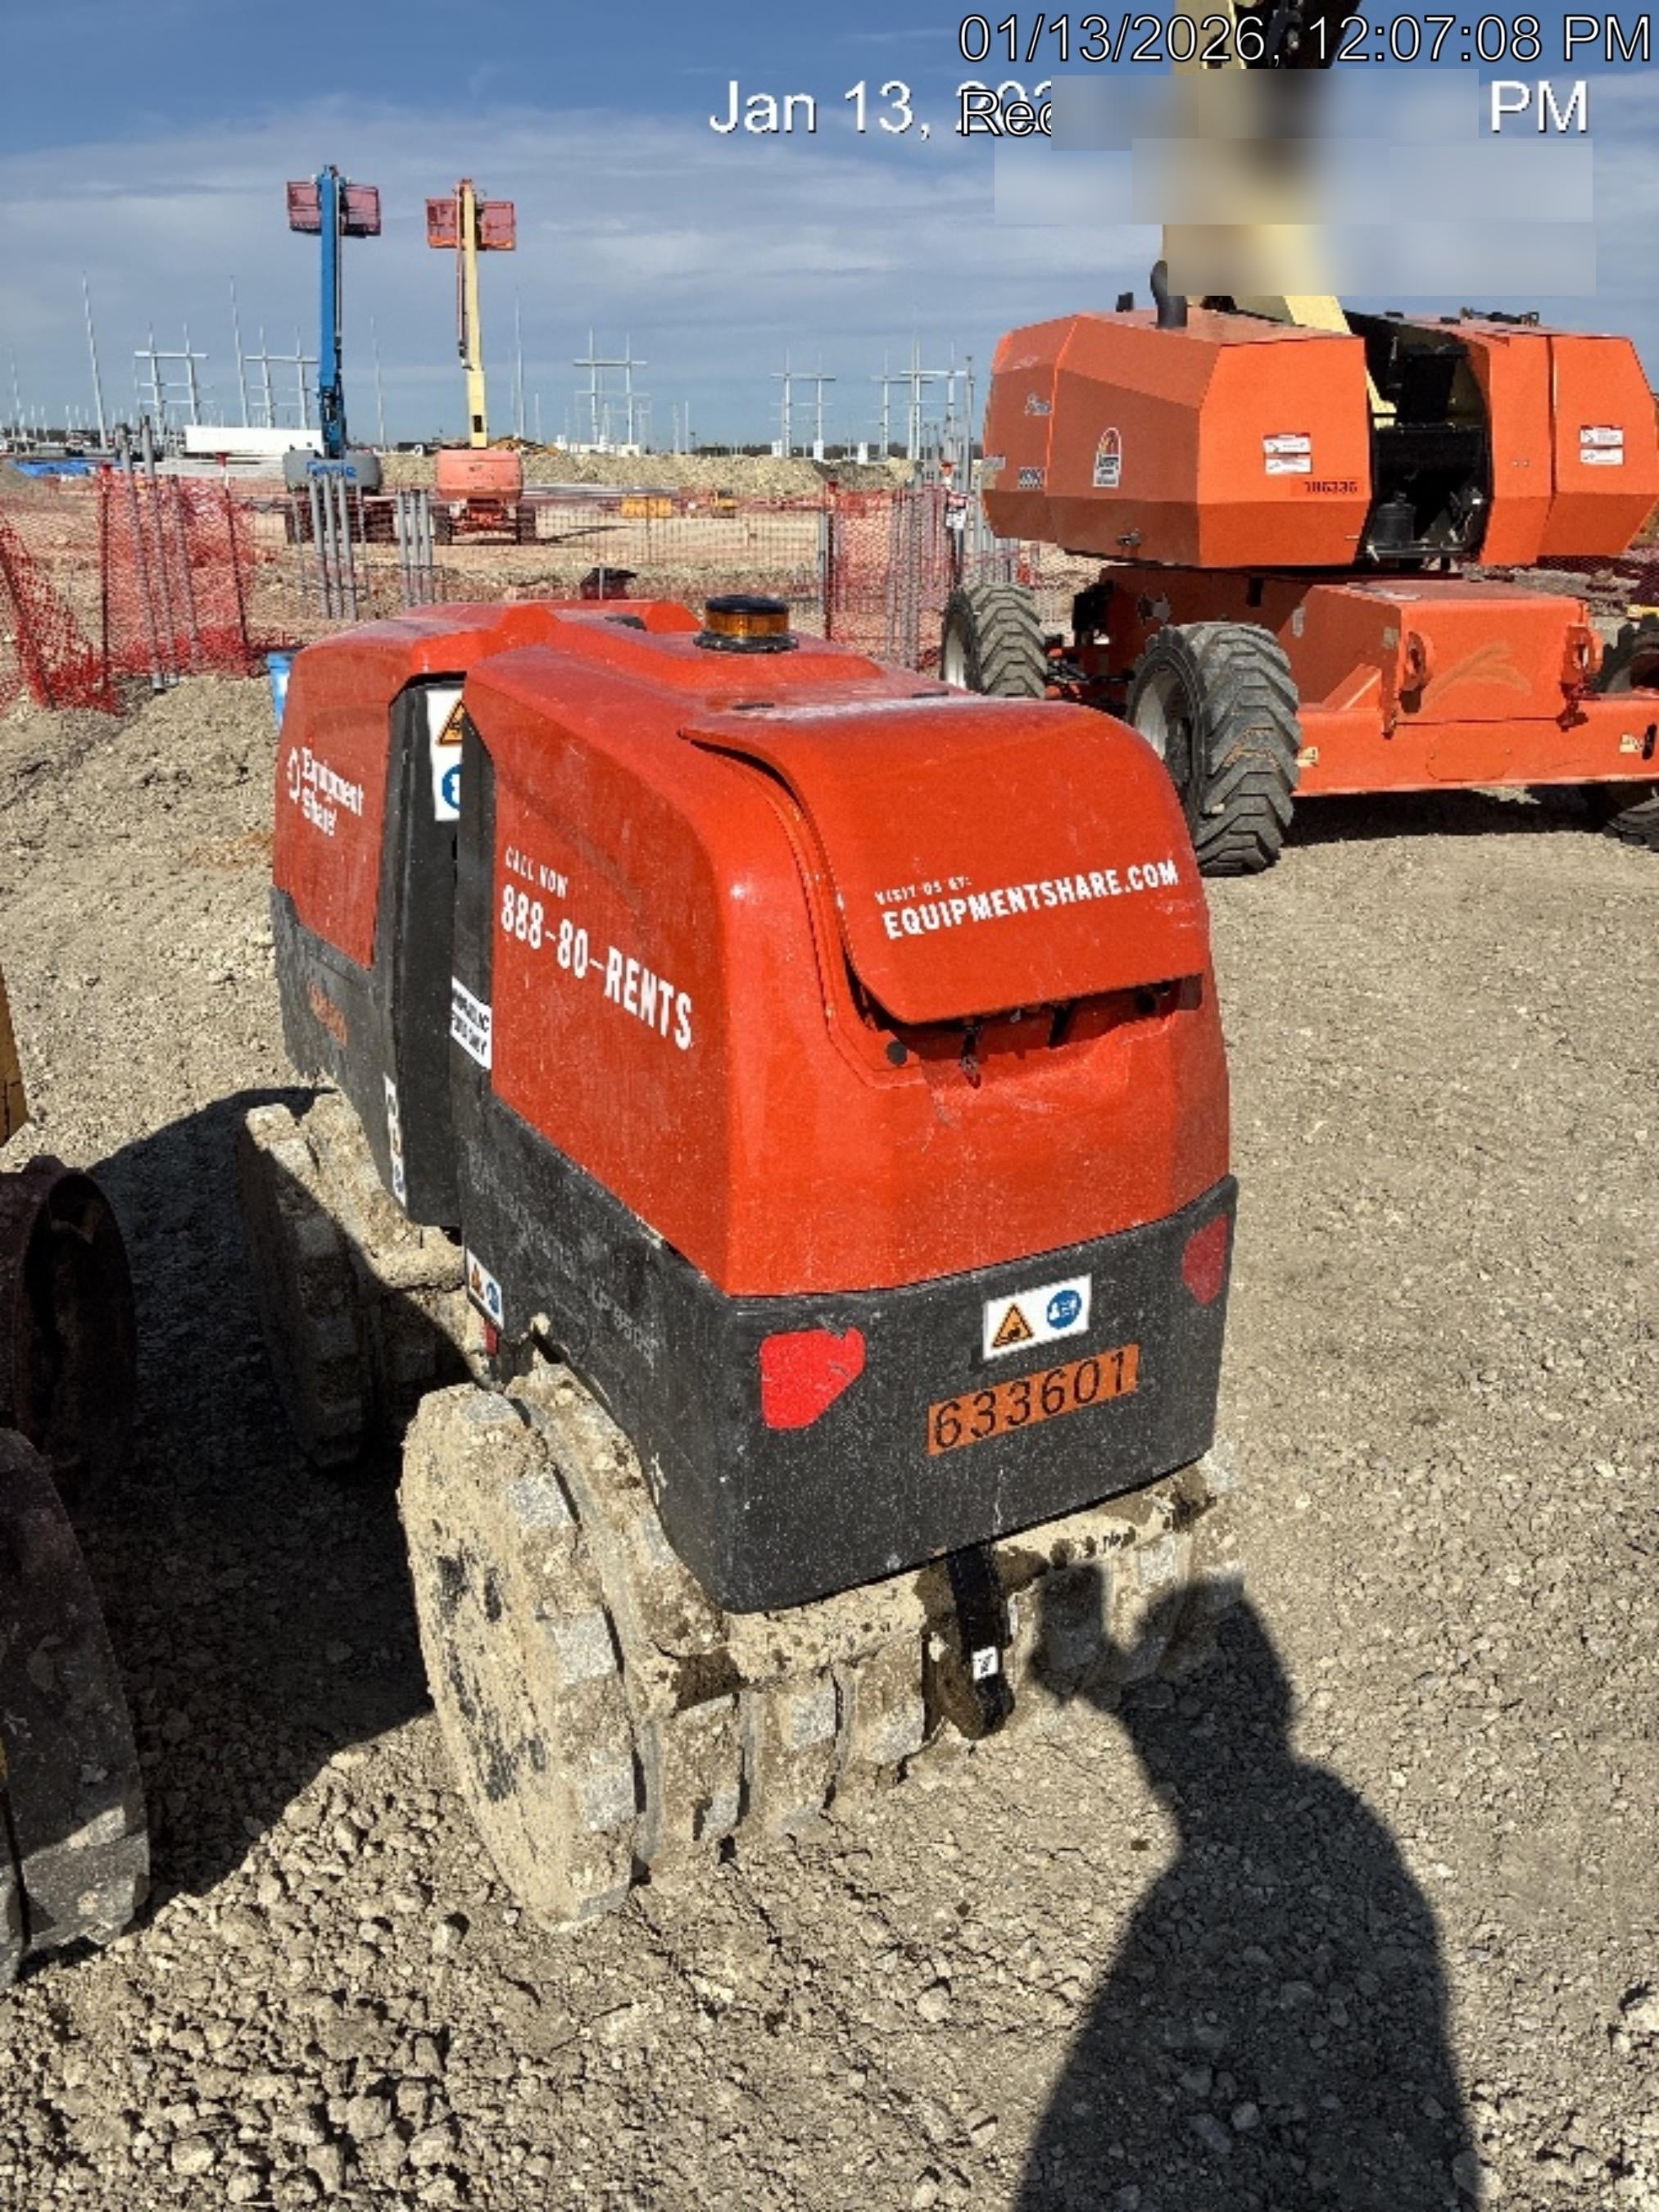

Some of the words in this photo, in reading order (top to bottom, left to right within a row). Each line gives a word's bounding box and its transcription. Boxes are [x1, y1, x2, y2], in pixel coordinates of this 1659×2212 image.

[301, 746, 365, 817] Equipment
[301, 786, 337, 836] Share
[505, 845, 534, 881] CALL
[540, 864, 569, 899] NOW
[874, 884, 916, 905] VISIT
[922, 880, 942, 895] US
[882, 859, 1178, 940] EQUIPMENTSHARE.COM
[501, 884, 691, 1050] 888-80-RENTS
[934, 1351, 1124, 1448] 633601
